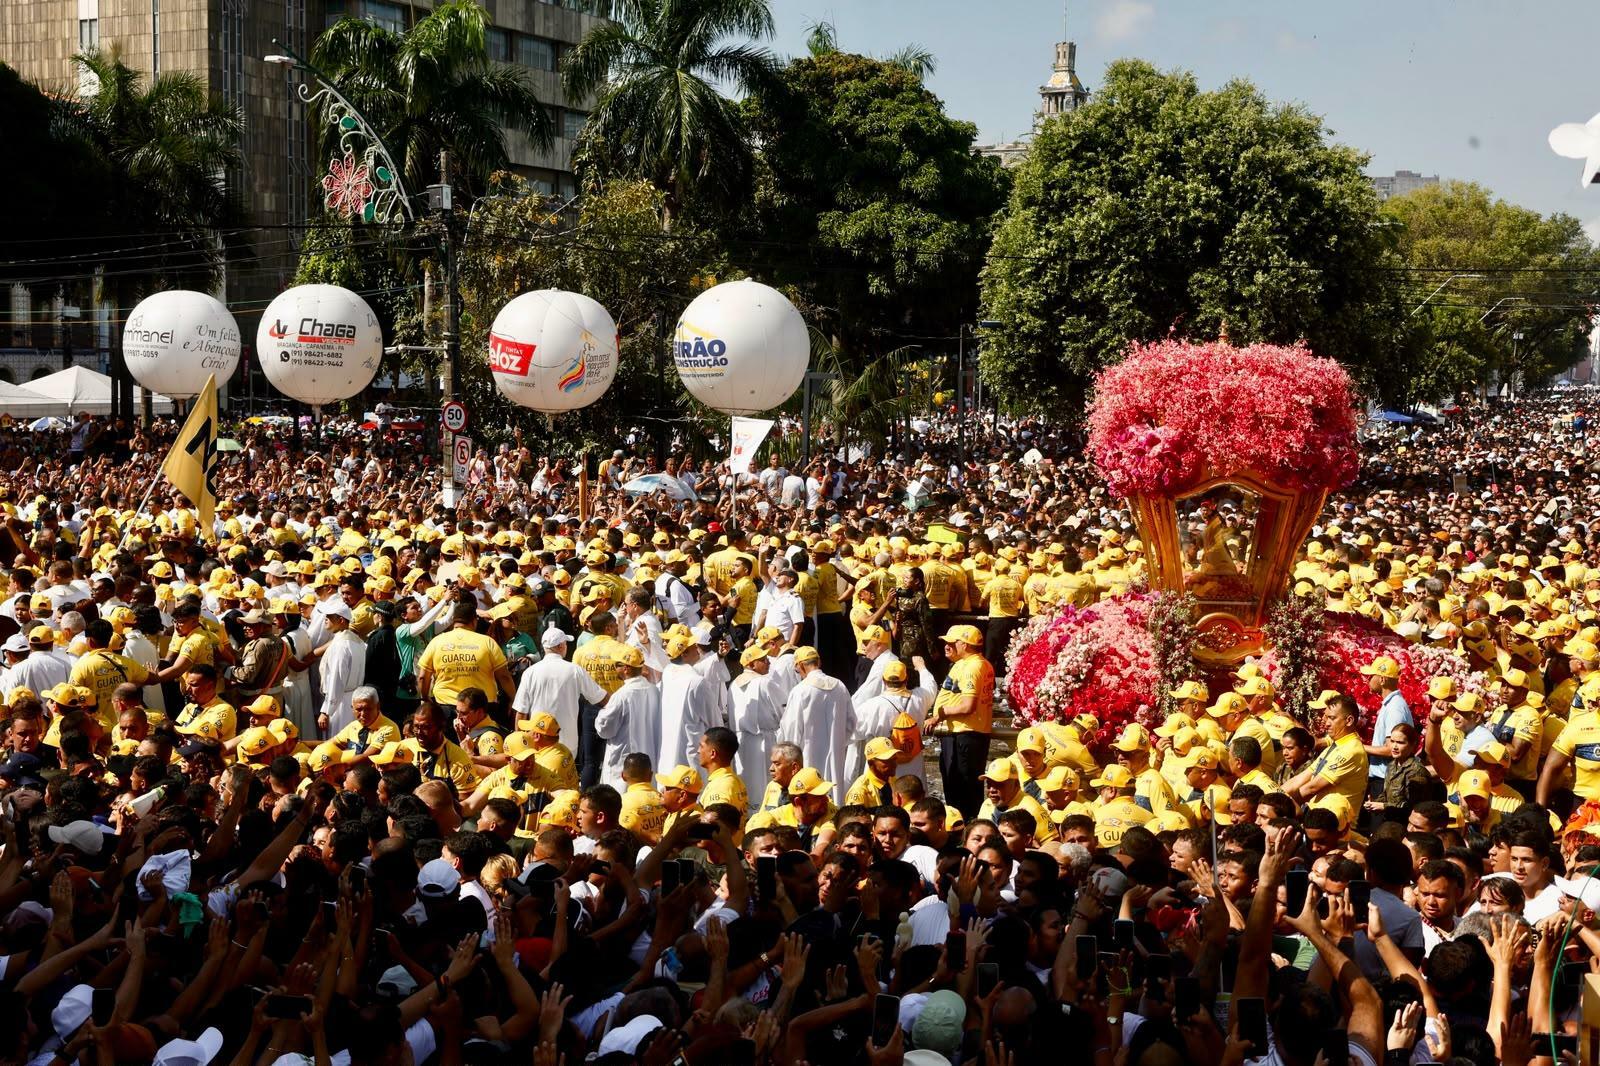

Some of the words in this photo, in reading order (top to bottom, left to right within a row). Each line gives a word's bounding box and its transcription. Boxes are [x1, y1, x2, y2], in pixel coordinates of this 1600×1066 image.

[196, 324, 217, 339] Um
[216, 327, 237, 343] feliz
[183, 341, 190, 350] e
[674, 336, 726, 358] EIRÃO
[291, 358, 302, 366] (91)
[490, 343, 522, 372] eloz
[447, 408, 463, 421] 50
[441, 653, 477, 663] GUARDA
[585, 662, 616, 672] GUARDA
